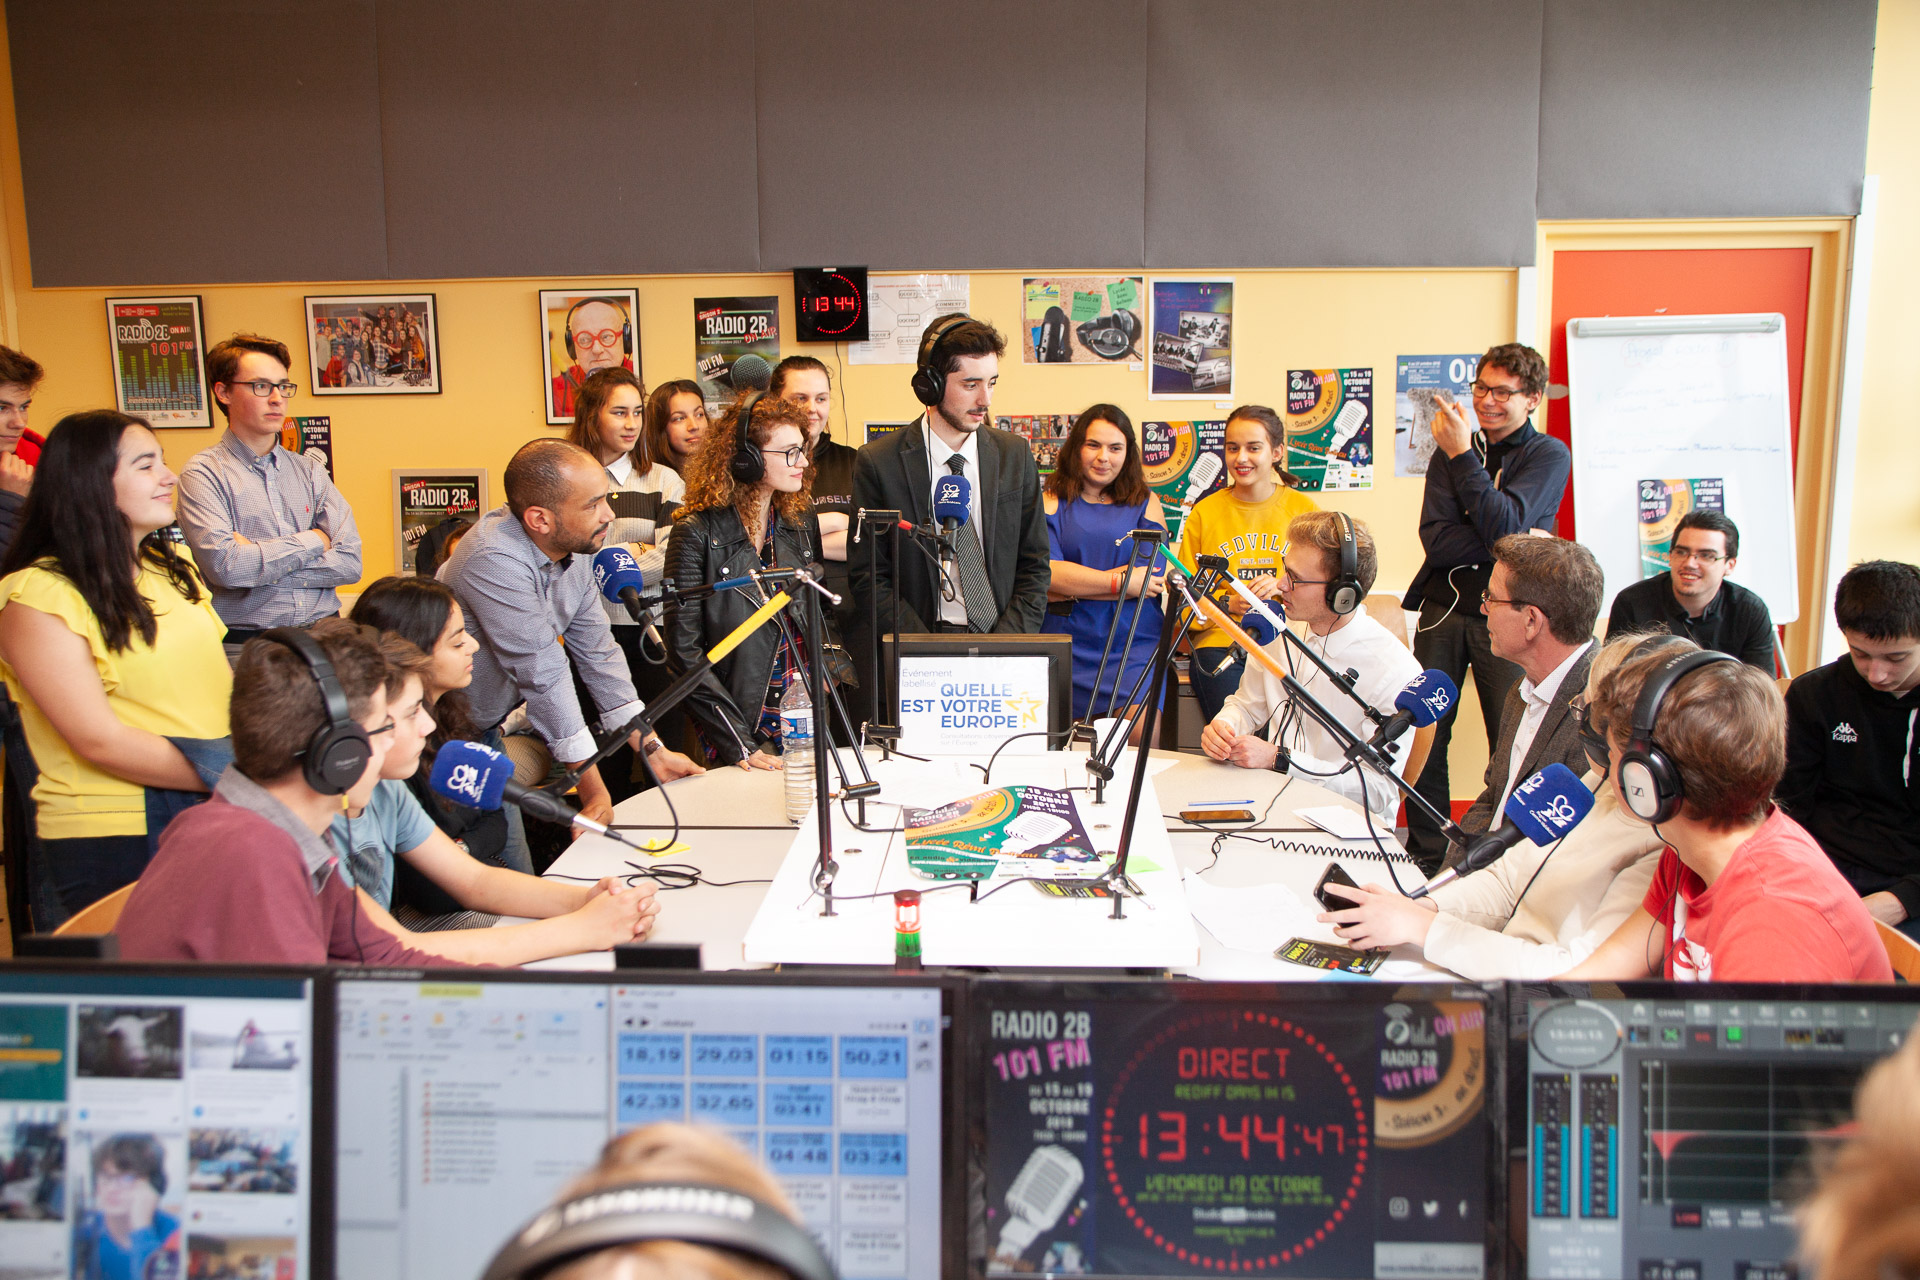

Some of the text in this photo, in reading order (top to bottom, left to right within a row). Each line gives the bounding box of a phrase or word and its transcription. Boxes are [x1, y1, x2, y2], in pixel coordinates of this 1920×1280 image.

[815, 296, 855, 312] 13 44
[117, 325, 154, 340] RADIO
[706, 316, 746, 335] RADIO
[744, 326, 777, 344] ON AIR
[151, 342, 178, 355] 101
[179, 341, 193, 350] FM
[698, 353, 725, 372] 101 FM
[1449, 357, 1477, 383] Où
[1344, 378, 1371, 386] OCTOBRE
[1290, 392, 1306, 400] RADIO
[1290, 399, 1315, 411] 101 FM
[1162, 443, 1169, 451] 2B
[1145, 451, 1170, 462] 101 FM
[411, 489, 449, 506] RADIO
[812, 494, 852, 506] URSELF
[446, 499, 478, 515] ON AIR
[403, 524, 427, 542] 101 FM
[1214, 533, 1292, 558] EDVILL
[902, 668, 952, 678] Événement
[902, 679, 936, 688] labellisé
[941, 683, 1012, 697] QUELLE
[901, 699, 1001, 713] EST VOTRE
[941, 715, 1018, 728] EUROPE
[1833, 733, 1857, 743] Kappa
[1017, 792, 1069, 806] OCTOBRE
[953, 840, 987, 854] Rémi
[991, 1010, 1091, 1039] RADIO 2B
[1434, 1016, 1456, 1036] ON
[992, 1037, 1091, 1081] 101 FM
[1178, 1047, 1291, 1080] DIRECT
[1381, 1049, 1419, 1067] RADIO
[1382, 1065, 1438, 1091] 101 FM
[1175, 1084, 1222, 1099] REDIFF
[1029, 1098, 1090, 1115] OCTOBRE
[770, 1149, 902, 1164] 04:48 03:24
[1146, 1174, 1225, 1193] VENDREDI
[1250, 1175, 1323, 1193] OCTOBRE
